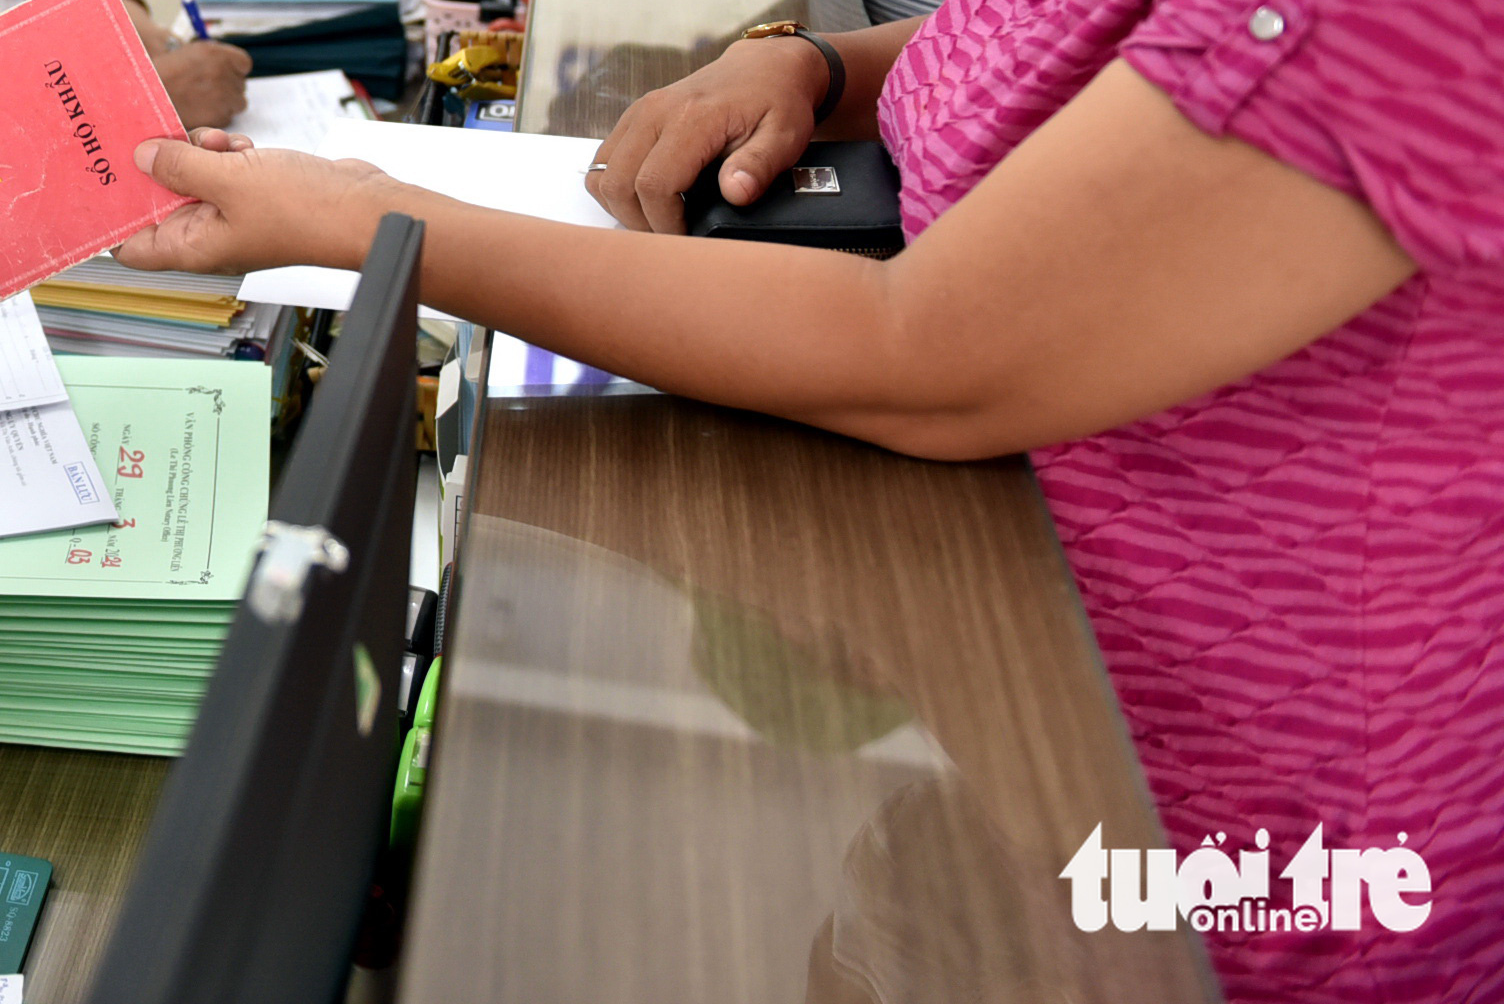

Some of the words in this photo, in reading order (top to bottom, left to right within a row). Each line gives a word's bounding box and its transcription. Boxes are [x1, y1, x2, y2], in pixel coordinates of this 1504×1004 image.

[43, 59, 86, 121] KHẨU
[73, 122, 103, 156] HỘ
[85, 157, 118, 186] SỔ
[185, 411, 196, 430] VĂN
[182, 431, 195, 461] PHÒNG
[116, 445, 146, 479] 29
[180, 462, 193, 486] CÔNG
[178, 486, 191, 514] CHỨNG
